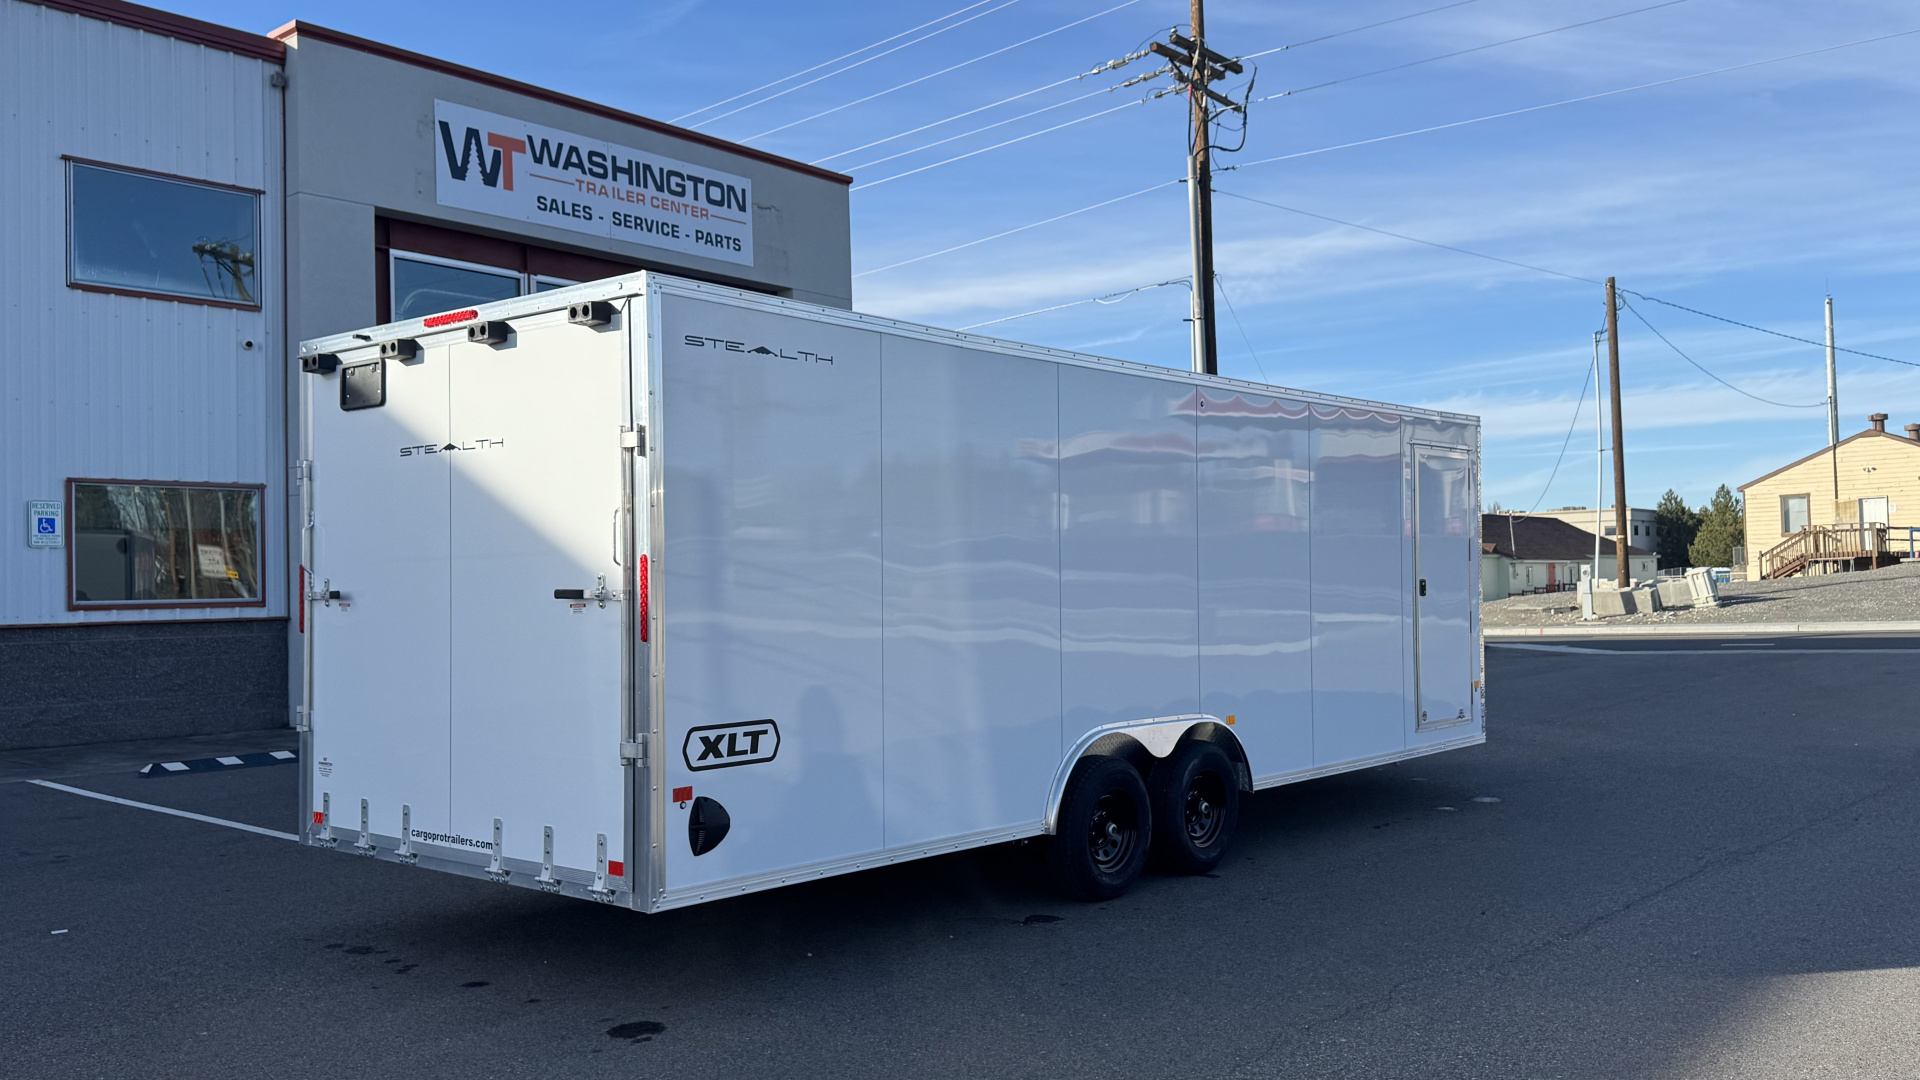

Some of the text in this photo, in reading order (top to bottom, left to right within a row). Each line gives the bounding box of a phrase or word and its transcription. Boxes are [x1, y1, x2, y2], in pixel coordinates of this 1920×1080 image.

[527, 134, 747, 213] WASHINGTON
[575, 178, 709, 220] TRAILER CENTER
[536, 195, 593, 221] SALES
[612, 211, 680, 239] SERVICE
[695, 229, 742, 252] PARTS
[31, 502, 61, 510] RESERVED
[696, 729, 769, 761] XLT
[411, 828, 493, 850] cargoprotrailers.com
